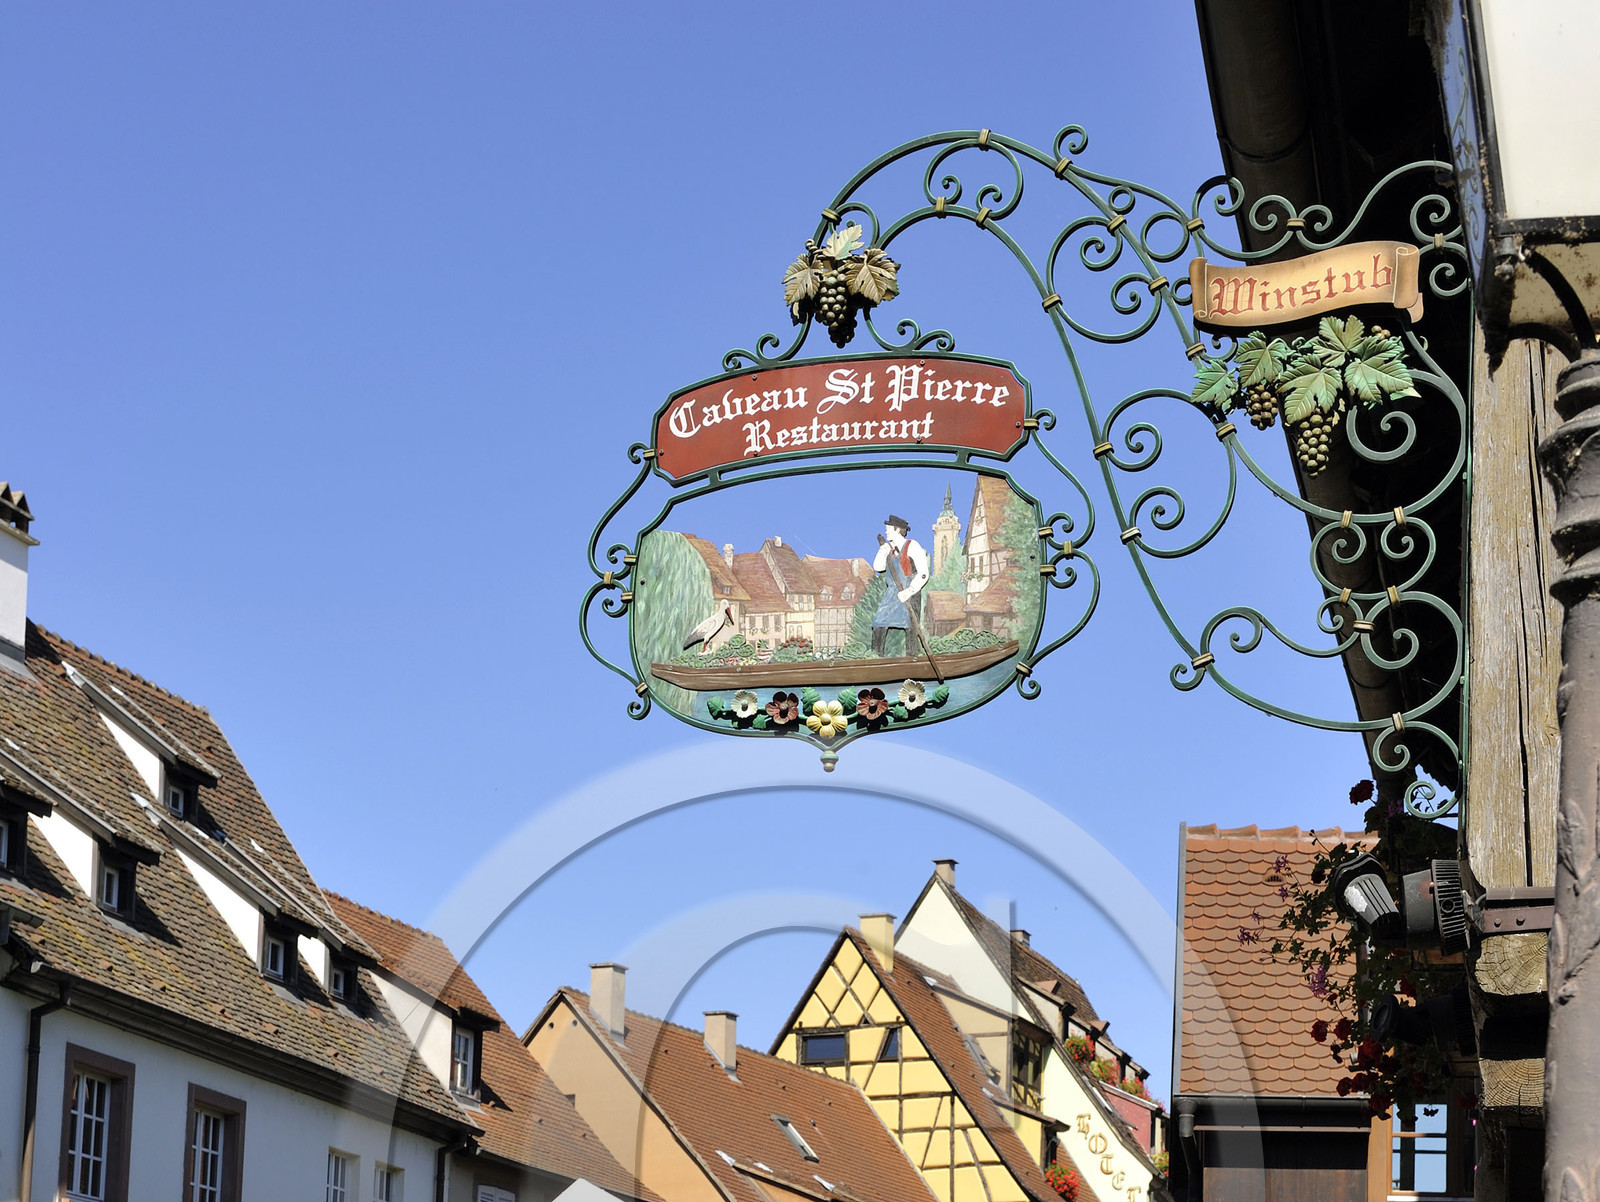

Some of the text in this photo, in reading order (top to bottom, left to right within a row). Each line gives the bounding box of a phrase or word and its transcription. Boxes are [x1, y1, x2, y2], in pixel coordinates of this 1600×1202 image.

[1210, 254, 1393, 318] Winstub
[668, 364, 1010, 439] Caveau St Pierre
[741, 411, 935, 457] Restaurant
